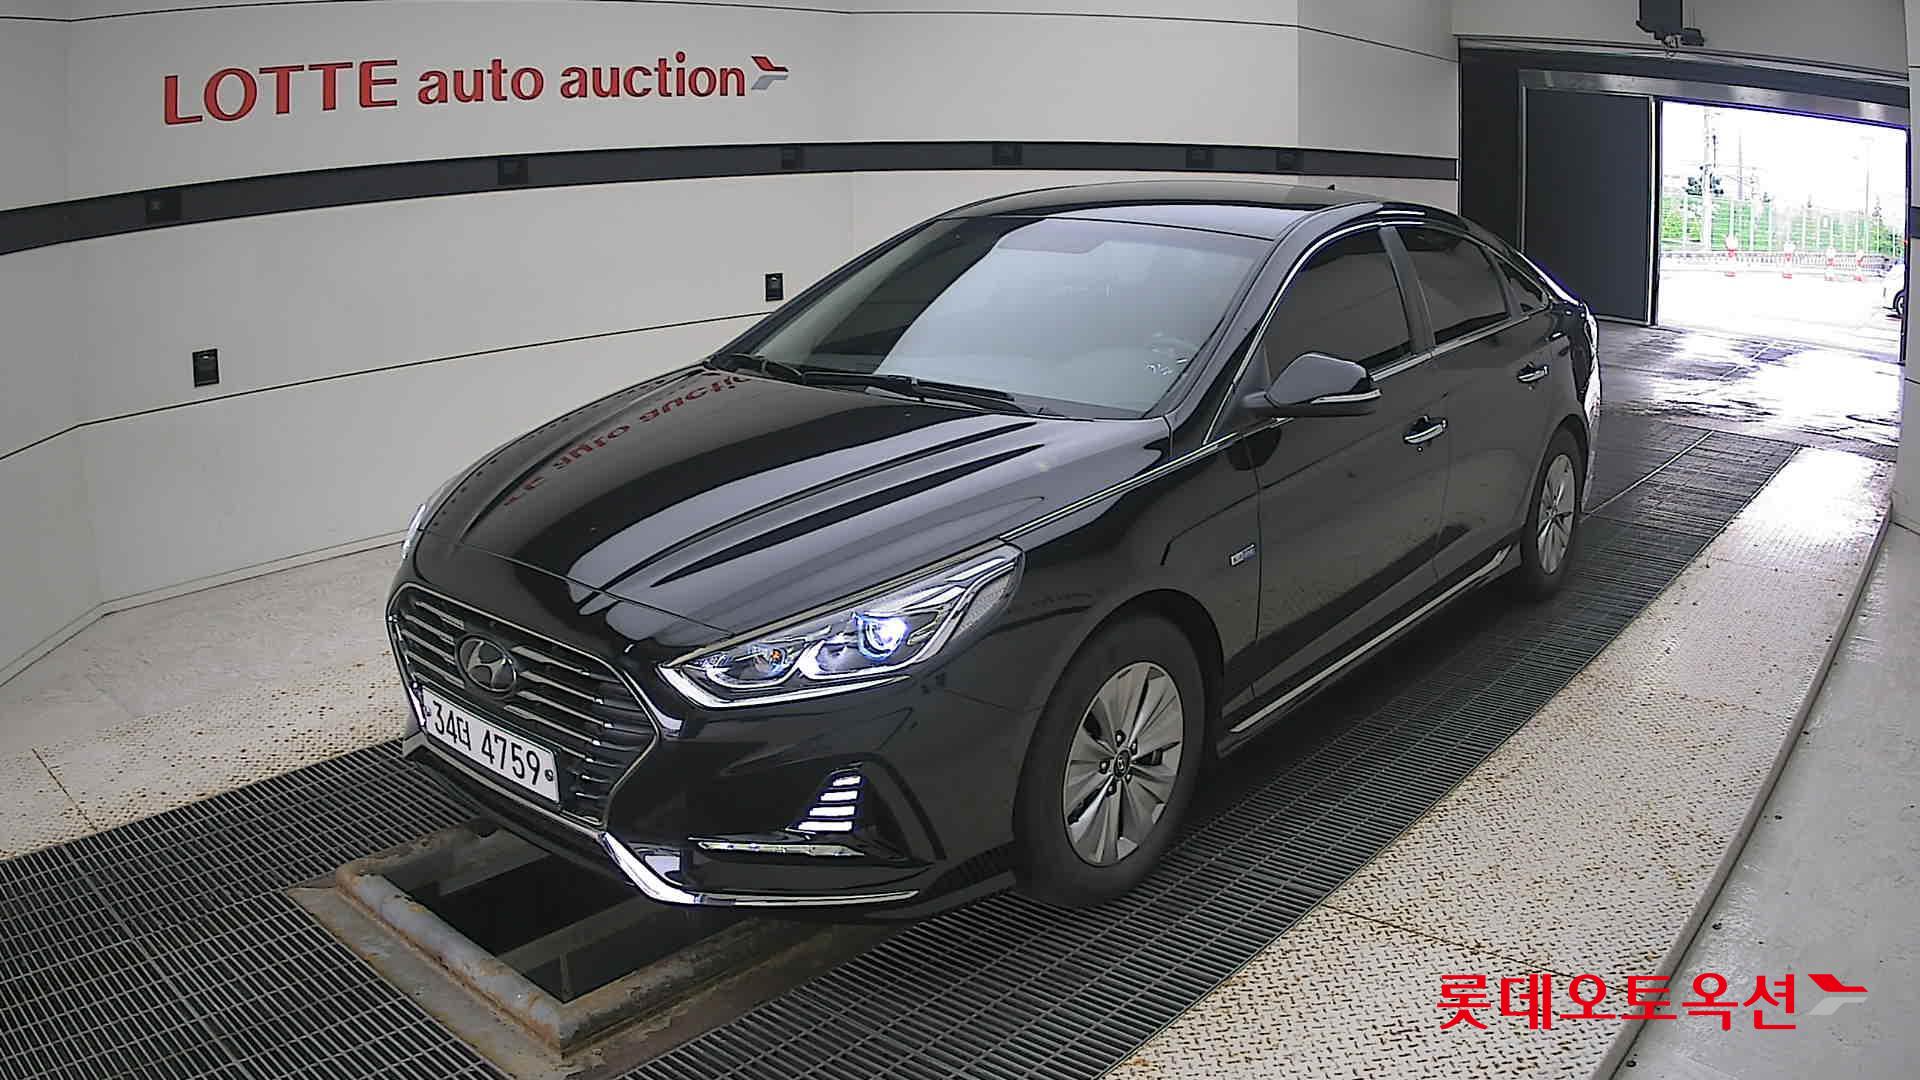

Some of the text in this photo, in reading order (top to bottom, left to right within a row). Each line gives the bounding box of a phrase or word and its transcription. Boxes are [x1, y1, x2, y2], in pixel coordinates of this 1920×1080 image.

[164, 50, 746, 125] LOTTE auto auction
[432, 700, 541, 786] 34더 4759
